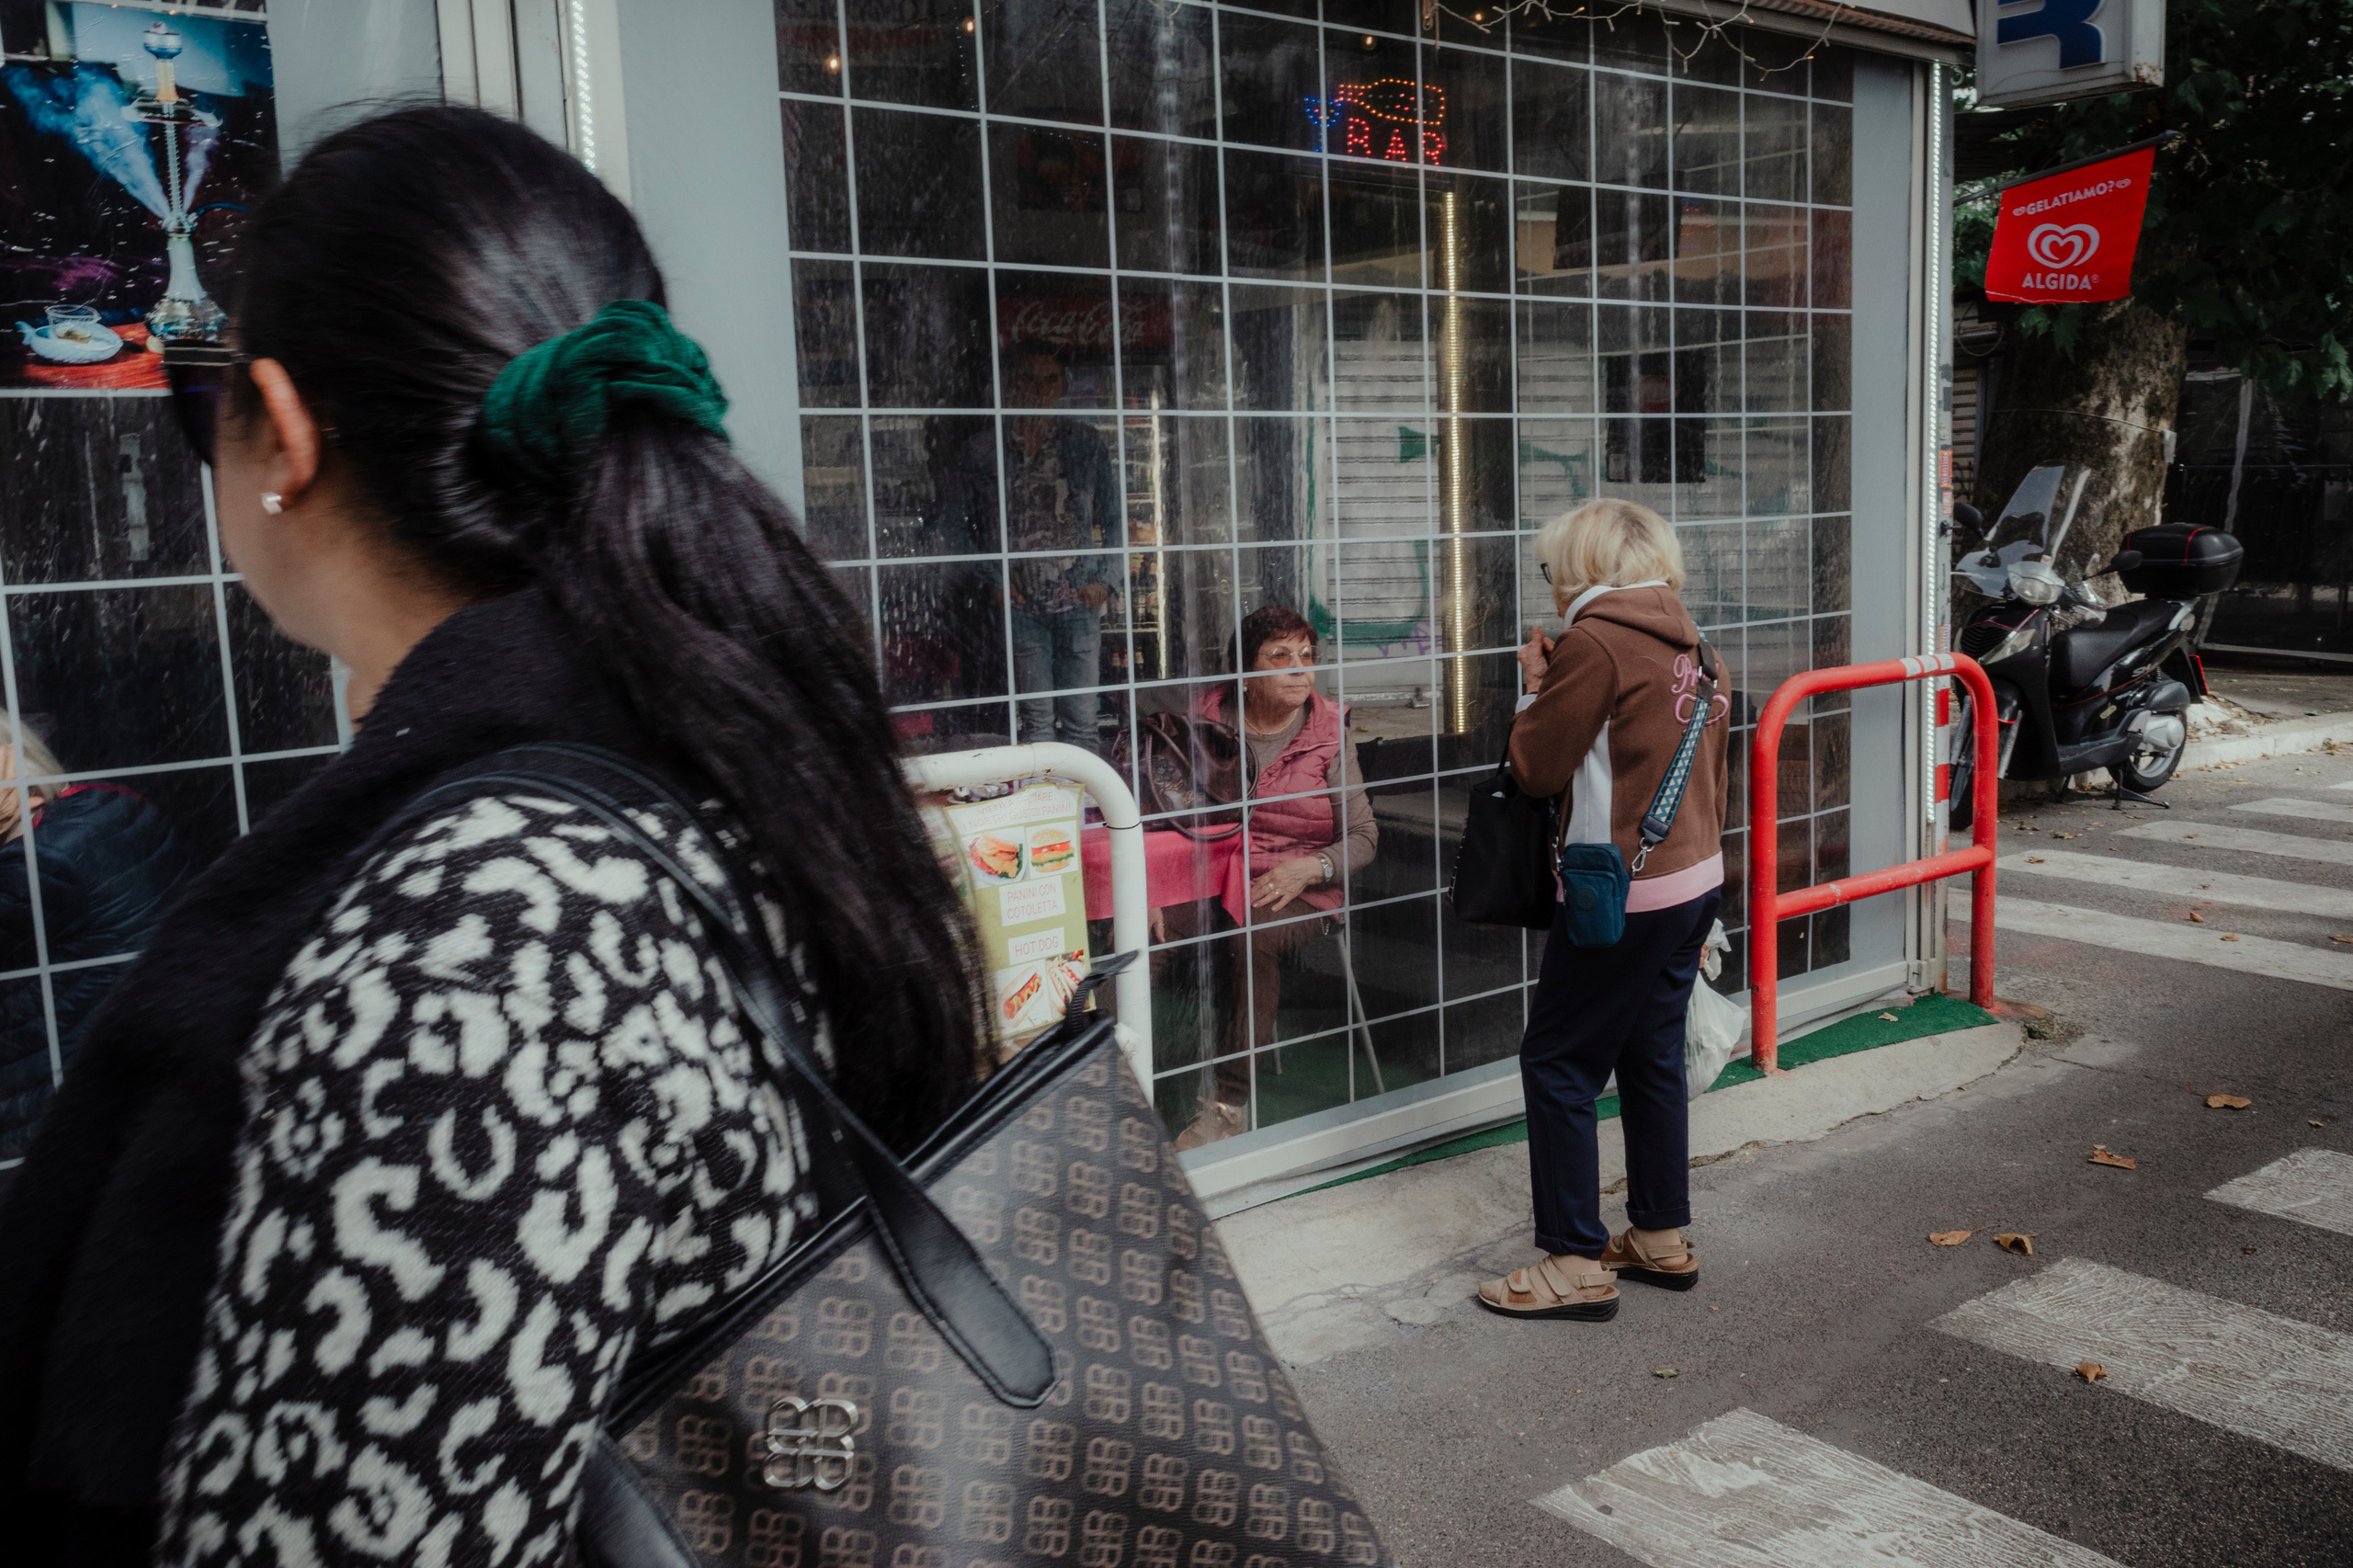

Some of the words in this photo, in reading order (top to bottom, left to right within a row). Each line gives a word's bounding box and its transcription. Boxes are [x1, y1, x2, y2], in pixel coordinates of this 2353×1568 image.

[2026, 180, 2115, 215] GELATIAMO?
[978, 801, 1006, 815] VIENI
[1008, 799, 1015, 807] A
[1042, 801, 1072, 815] PANINI
[1006, 886, 1037, 903] PANINI
[1039, 882, 1056, 896] CON
[1006, 899, 1058, 920] COTOLETTA
[1015, 940, 1036, 957] HOT
[1039, 936, 1059, 952] DOG
